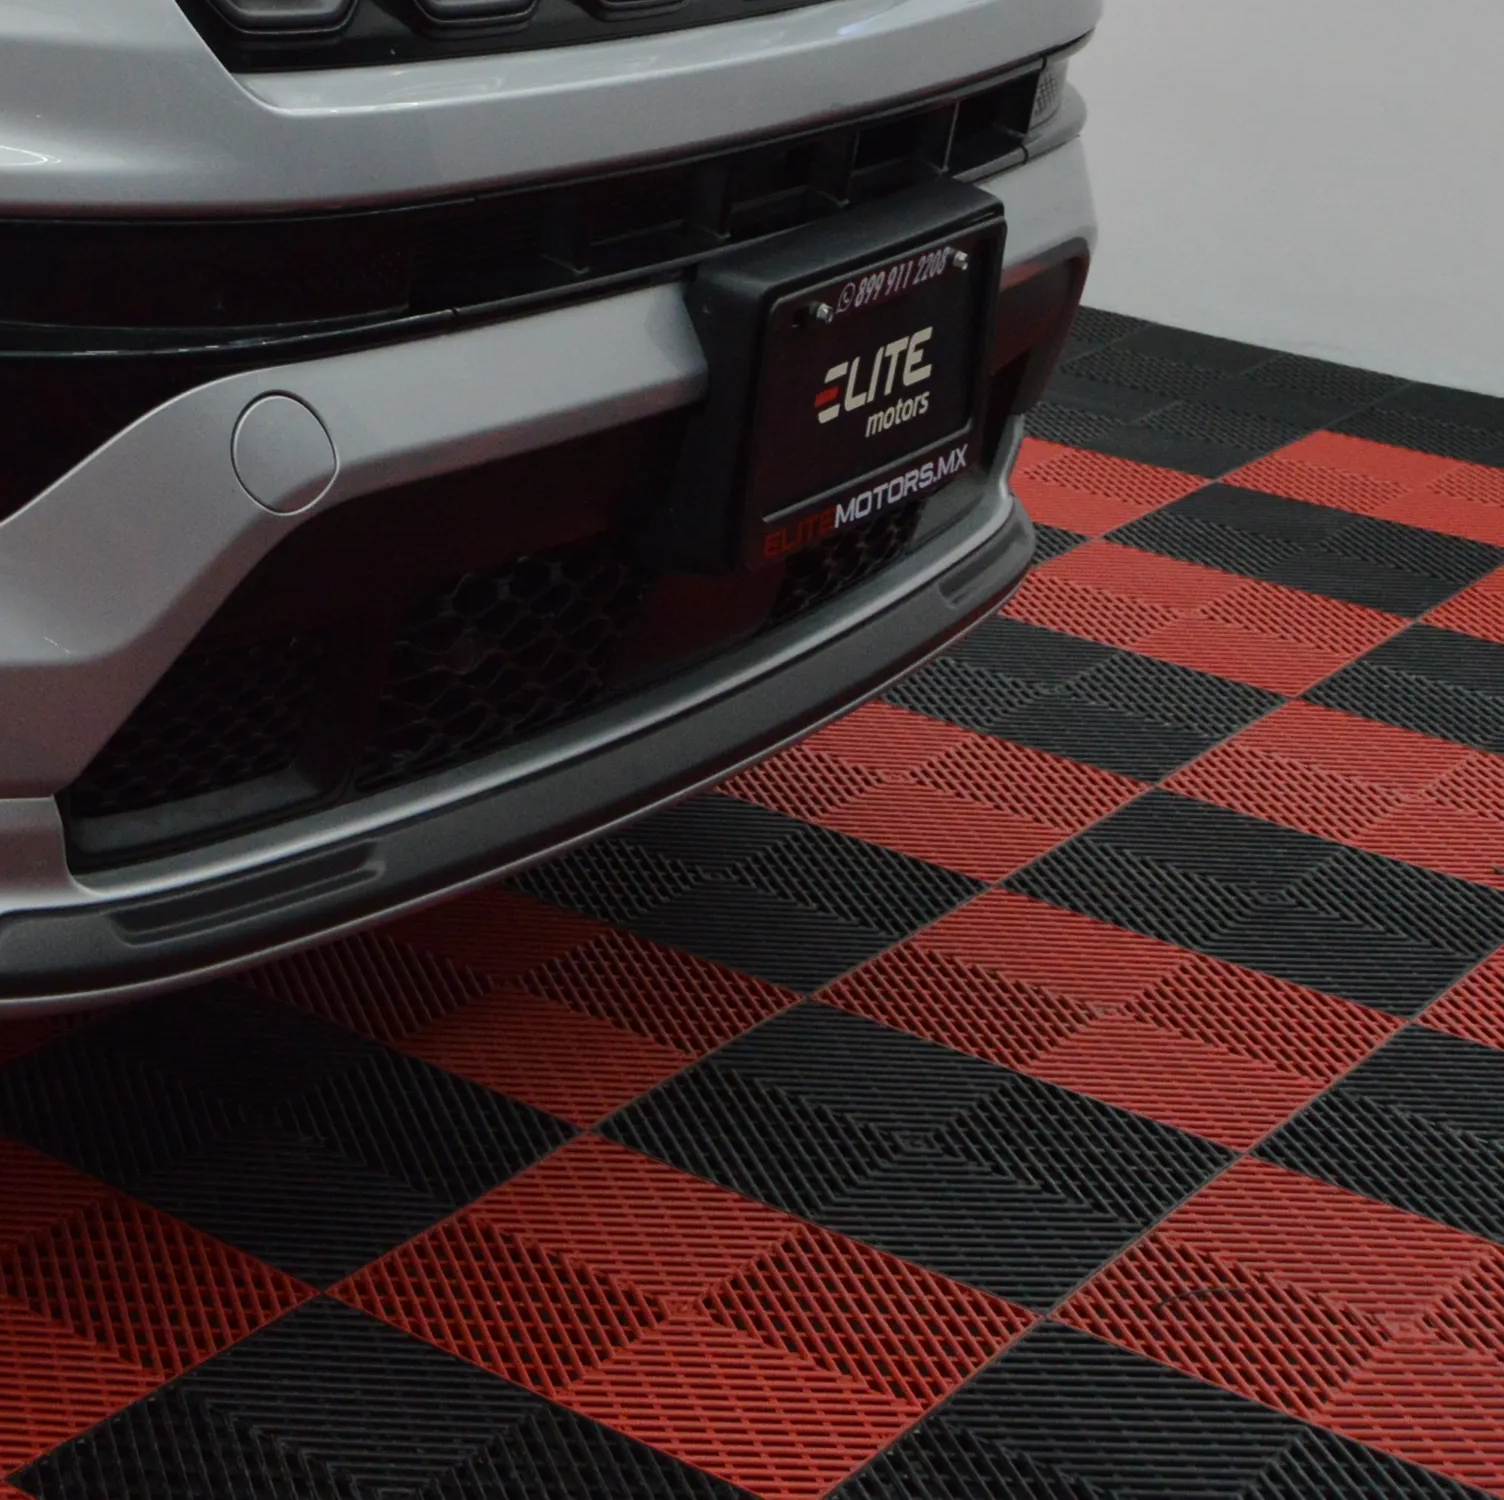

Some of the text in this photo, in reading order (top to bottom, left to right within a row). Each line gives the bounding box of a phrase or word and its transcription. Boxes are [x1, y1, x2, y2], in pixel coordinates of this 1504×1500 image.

[854, 271, 886, 308] 899
[885, 260, 914, 296] 911
[814, 326, 933, 424] ELITE
[865, 391, 930, 438] motors
